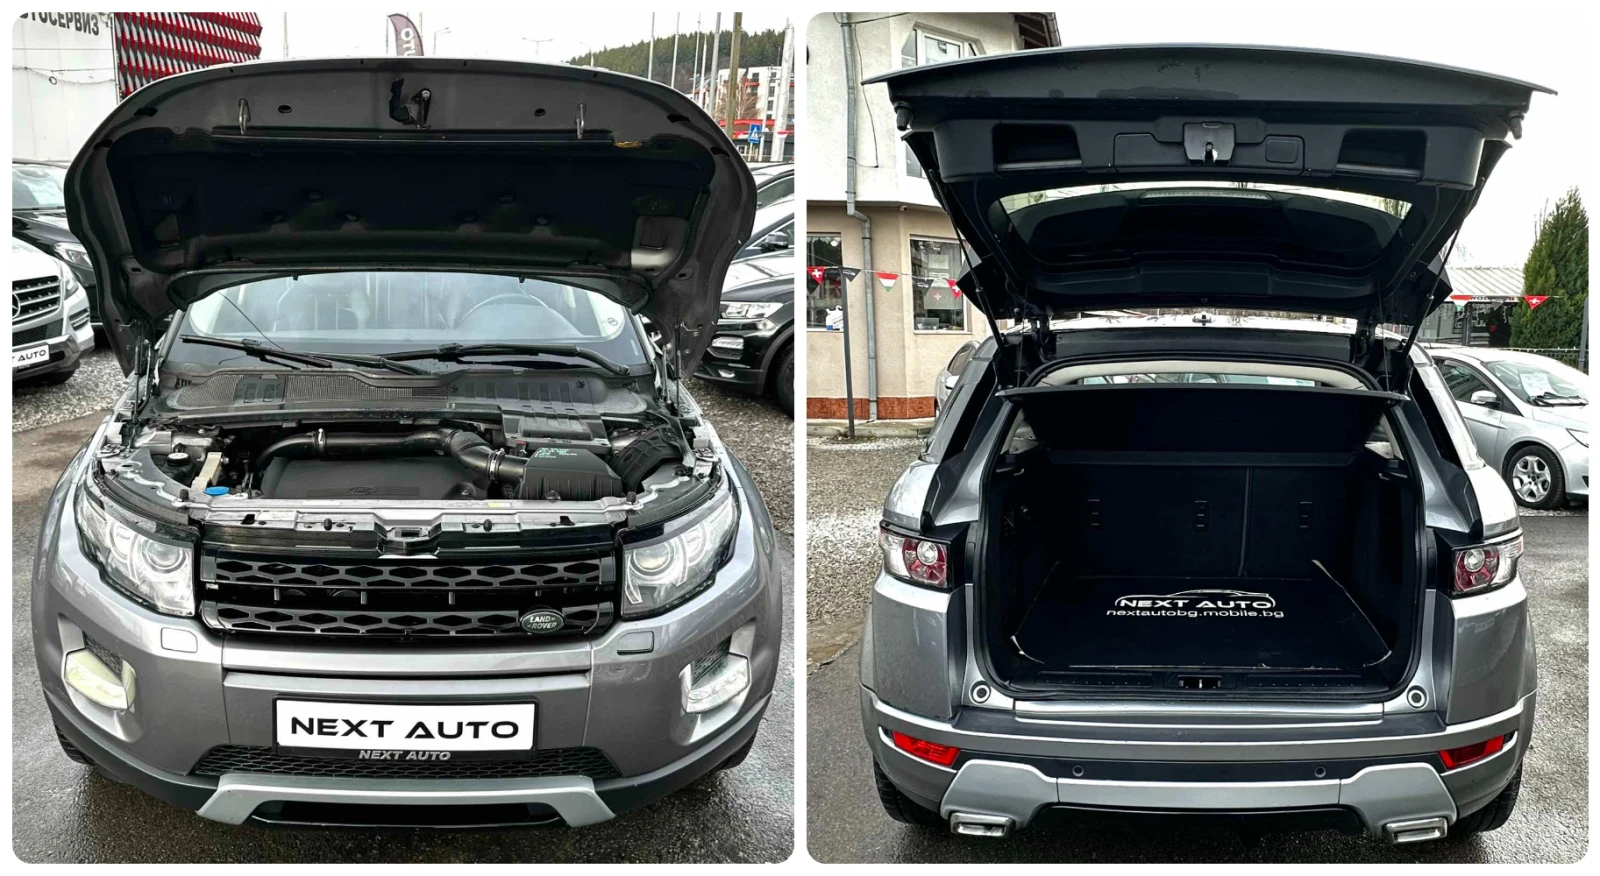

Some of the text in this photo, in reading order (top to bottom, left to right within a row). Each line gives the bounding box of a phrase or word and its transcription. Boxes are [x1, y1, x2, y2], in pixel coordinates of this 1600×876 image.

[18, 349, 47, 362] AUTO
[1119, 599, 1272, 609] NEXT AUTO
[1106, 609, 1284, 618] nextautobg.mobile.bg
[291, 716, 519, 739] NEXT AUTO
[358, 750, 451, 761] NEXT AUTO
